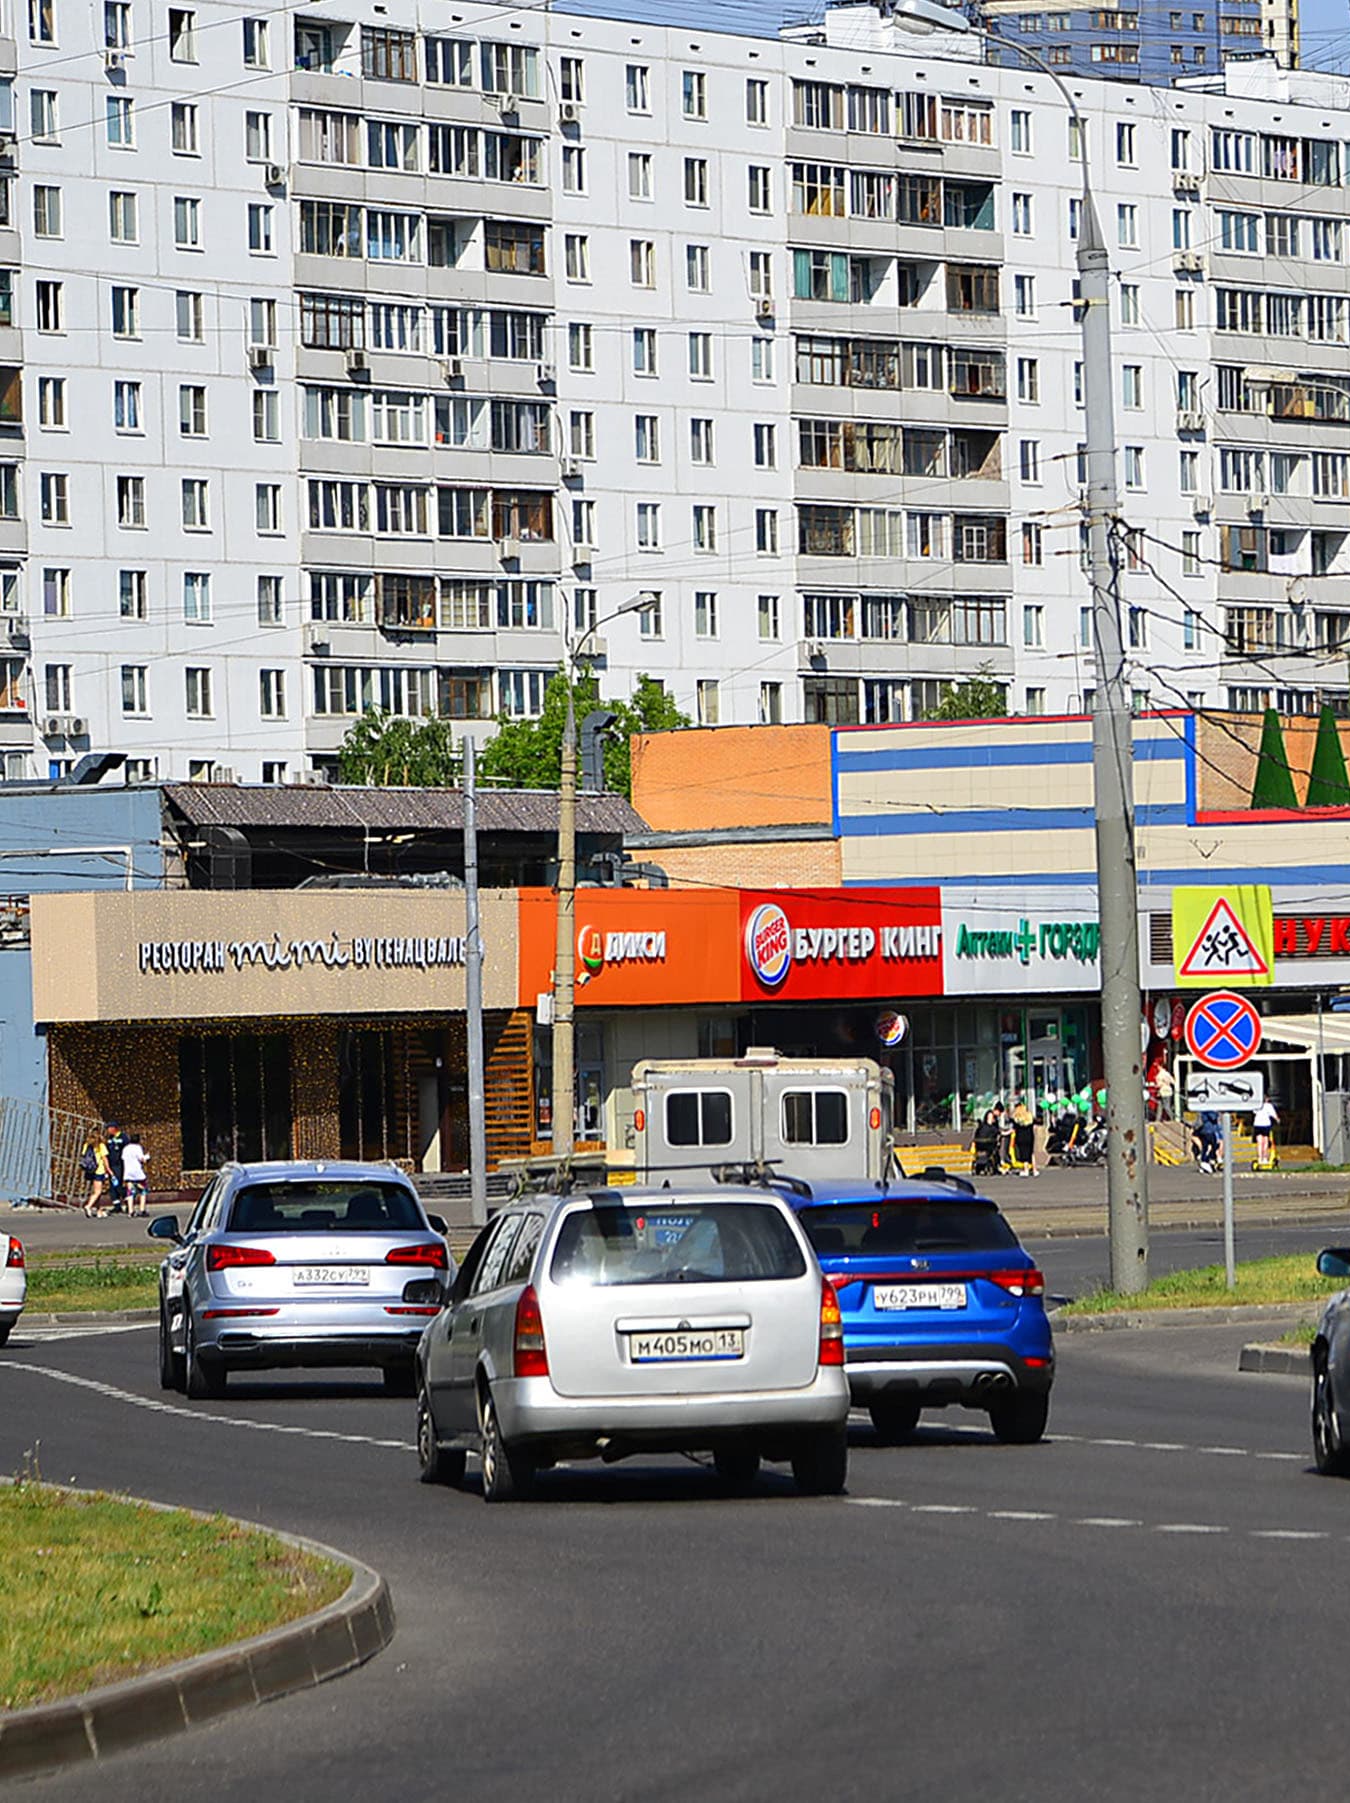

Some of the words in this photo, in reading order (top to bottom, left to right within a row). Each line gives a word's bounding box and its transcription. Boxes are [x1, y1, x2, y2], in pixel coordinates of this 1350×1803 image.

[604, 930, 666, 961] ДИКСИ
[755, 916, 785, 950] BURGER
[757, 930, 788, 969] KING
[793, 926, 875, 959] БУРГЕР
[879, 925, 942, 957] КИНГ
[140, 942, 224, 969] РЕСТОРАН
[227, 932, 350, 969] mimi
[352, 938, 373, 964] BY
[940, 1287, 961, 1299] 799
[637, 1336, 713, 1355] М405МО
[719, 1332, 736, 1348] 13
